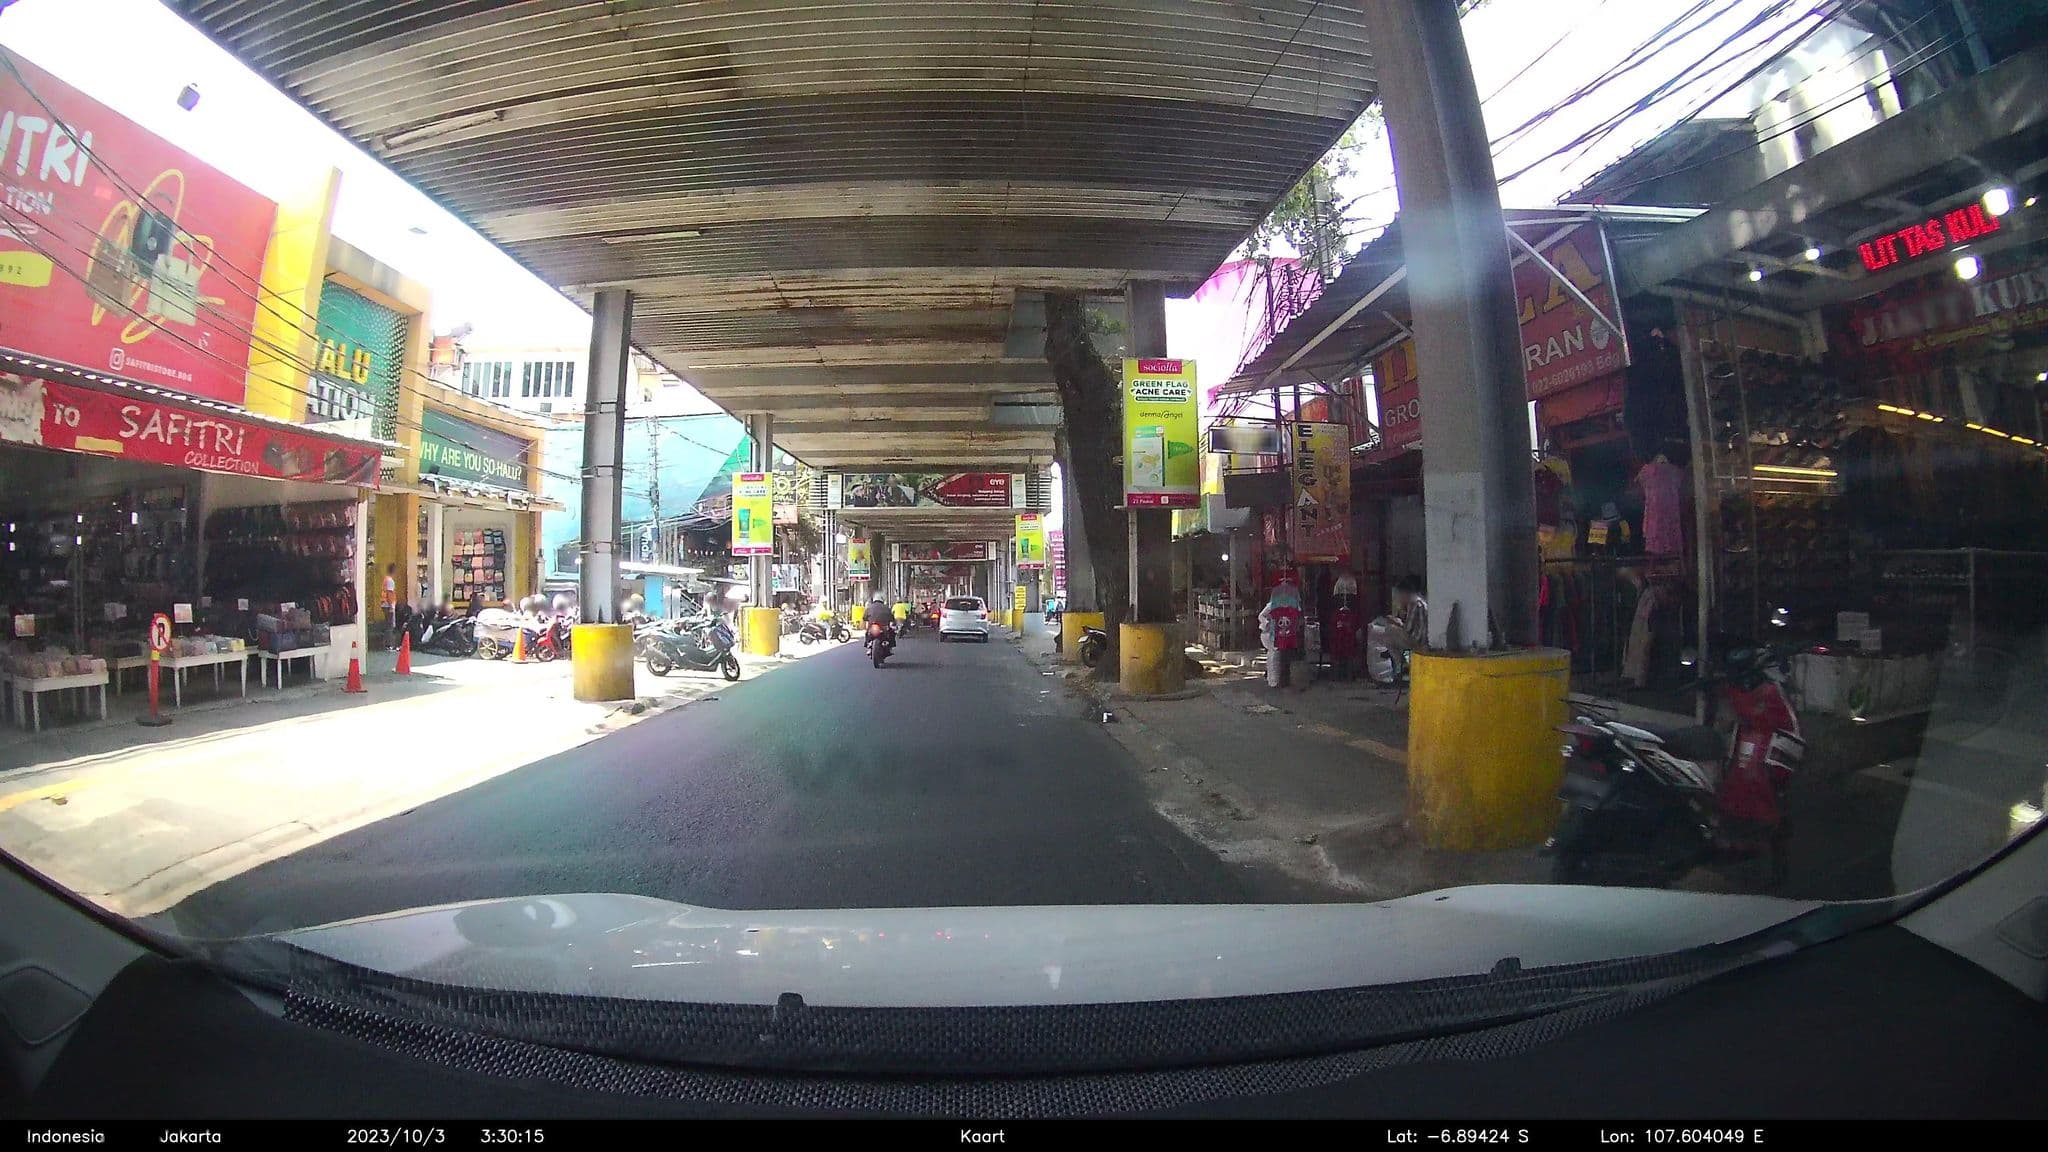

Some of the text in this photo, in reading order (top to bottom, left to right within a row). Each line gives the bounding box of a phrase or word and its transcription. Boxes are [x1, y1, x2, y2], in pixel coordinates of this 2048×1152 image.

[1897, 219, 1946, 258] TAS
[1133, 380, 1189, 388] GREEN FLAG
[53, 403, 81, 428] TO
[118, 405, 245, 456] SAFITRI
[184, 450, 260, 474] COLLECTION
[440, 446, 461, 468] ARE
[463, 451, 482, 472] YOU
[482, 457, 496, 475] SO
[496, 461, 522, 481] HALU?
[1297, 424, 1319, 538] ELEGANT
